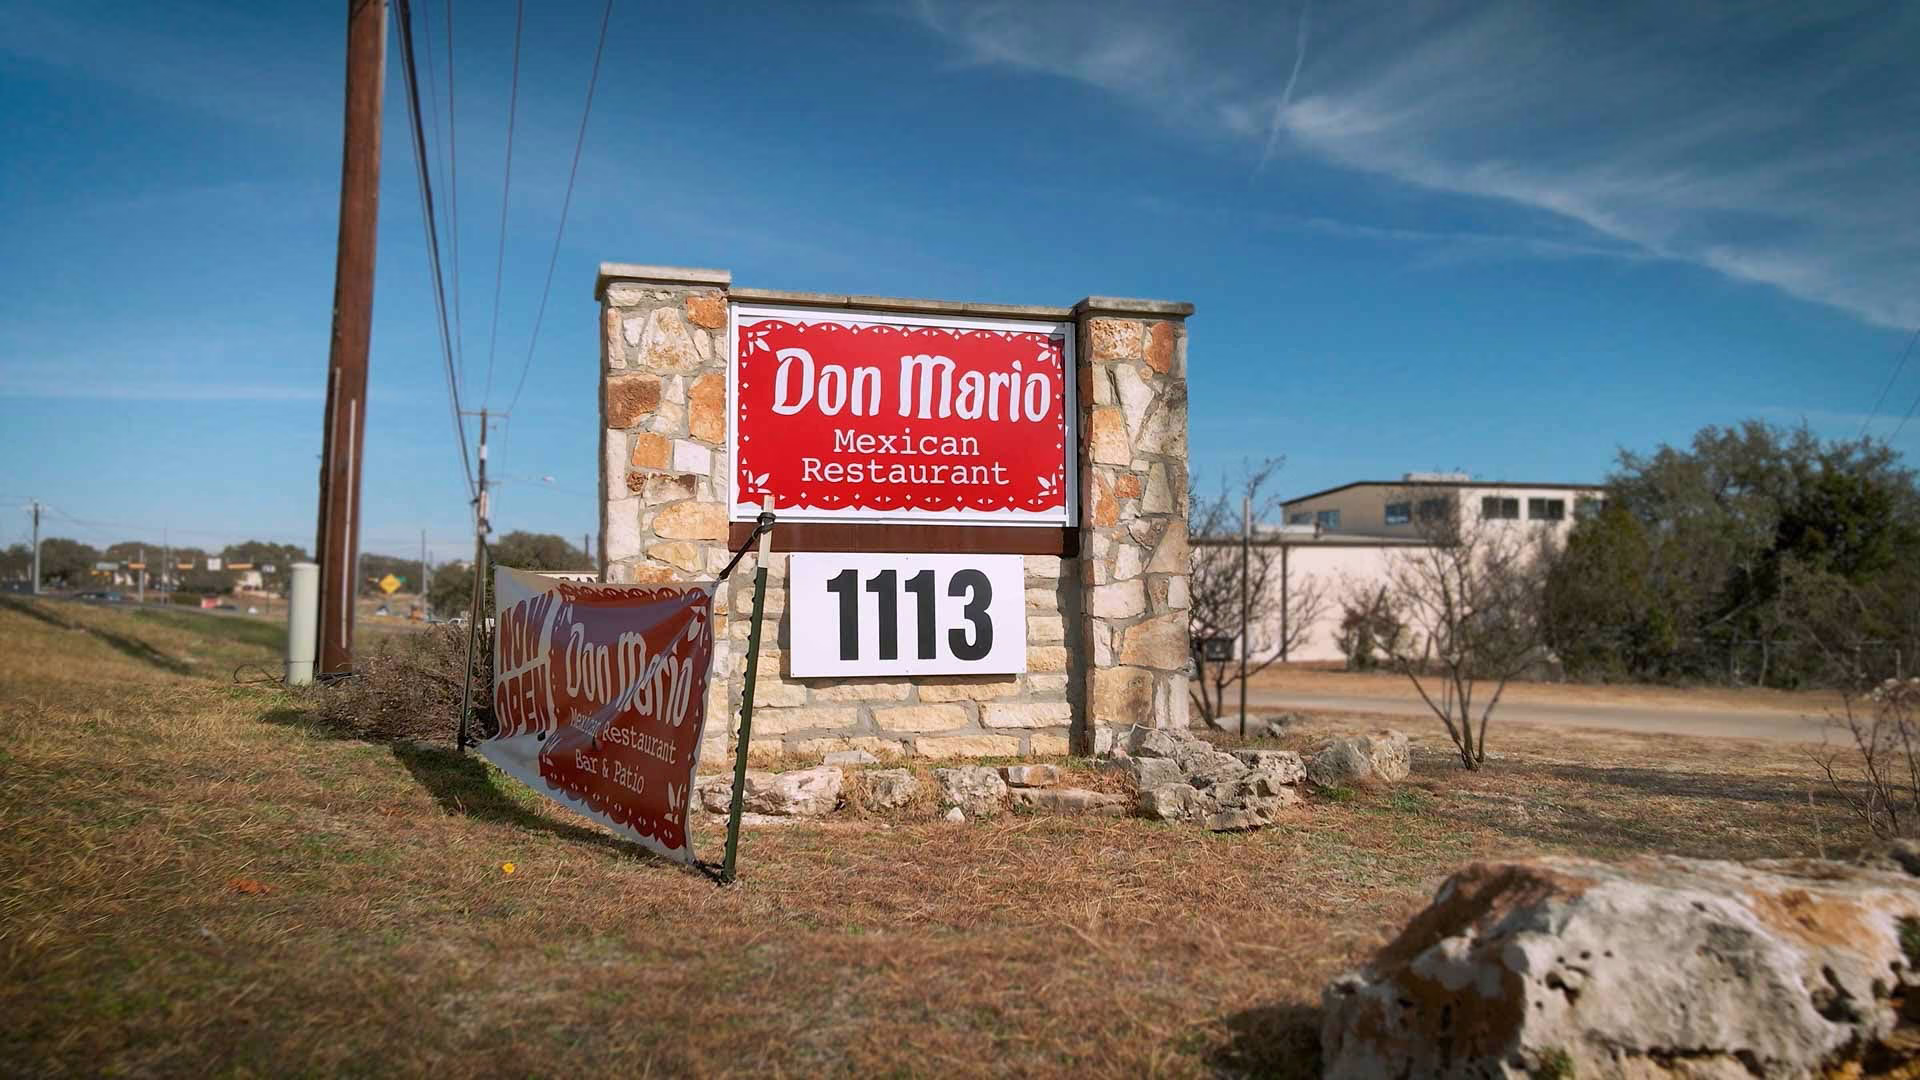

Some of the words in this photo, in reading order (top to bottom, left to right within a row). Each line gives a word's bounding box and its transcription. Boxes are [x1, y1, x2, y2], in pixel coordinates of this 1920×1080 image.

[772, 347, 882, 416] Don
[898, 354, 1051, 423] Mario
[801, 457, 1010, 486] Restaurant
[833, 428, 980, 457] Mexican
[500, 589, 553, 675] NOW
[827, 569, 993, 660] 1113
[496, 663, 551, 741] OPEN
[566, 622, 611, 705] Don
[615, 631, 693, 728] Mario
[575, 748, 599, 774] Bar
[602, 758, 610, 779] &
[613, 760, 645, 795] Patio
[602, 720, 677, 765] Restaurant
